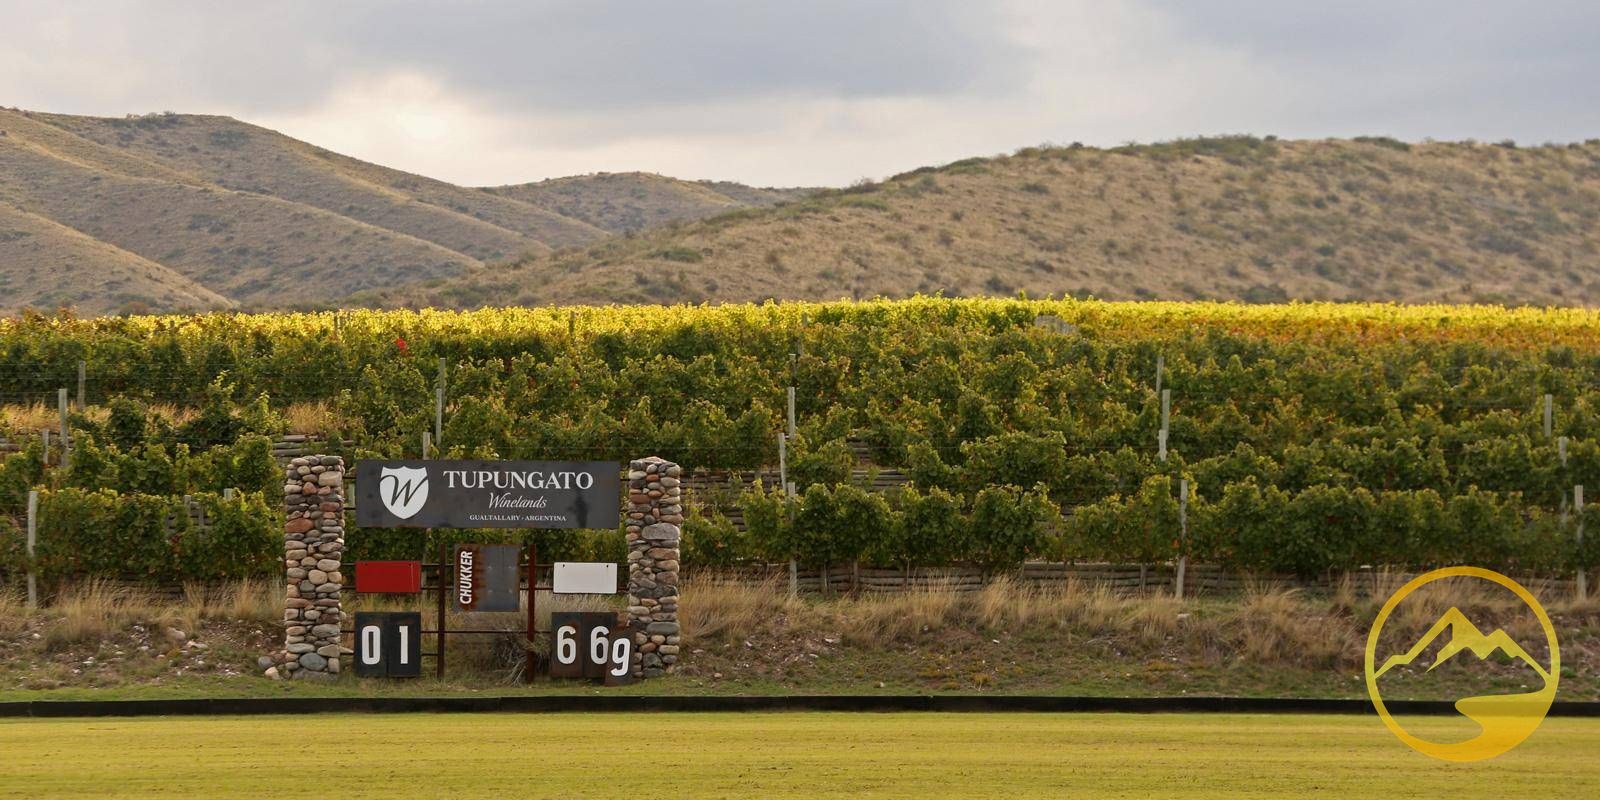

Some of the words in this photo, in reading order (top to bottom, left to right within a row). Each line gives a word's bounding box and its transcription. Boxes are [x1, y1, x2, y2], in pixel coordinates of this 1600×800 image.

[443, 471, 593, 490] TUPUNGATO
[488, 492, 548, 509] Winelands
[459, 550, 473, 605] CHUKKER
